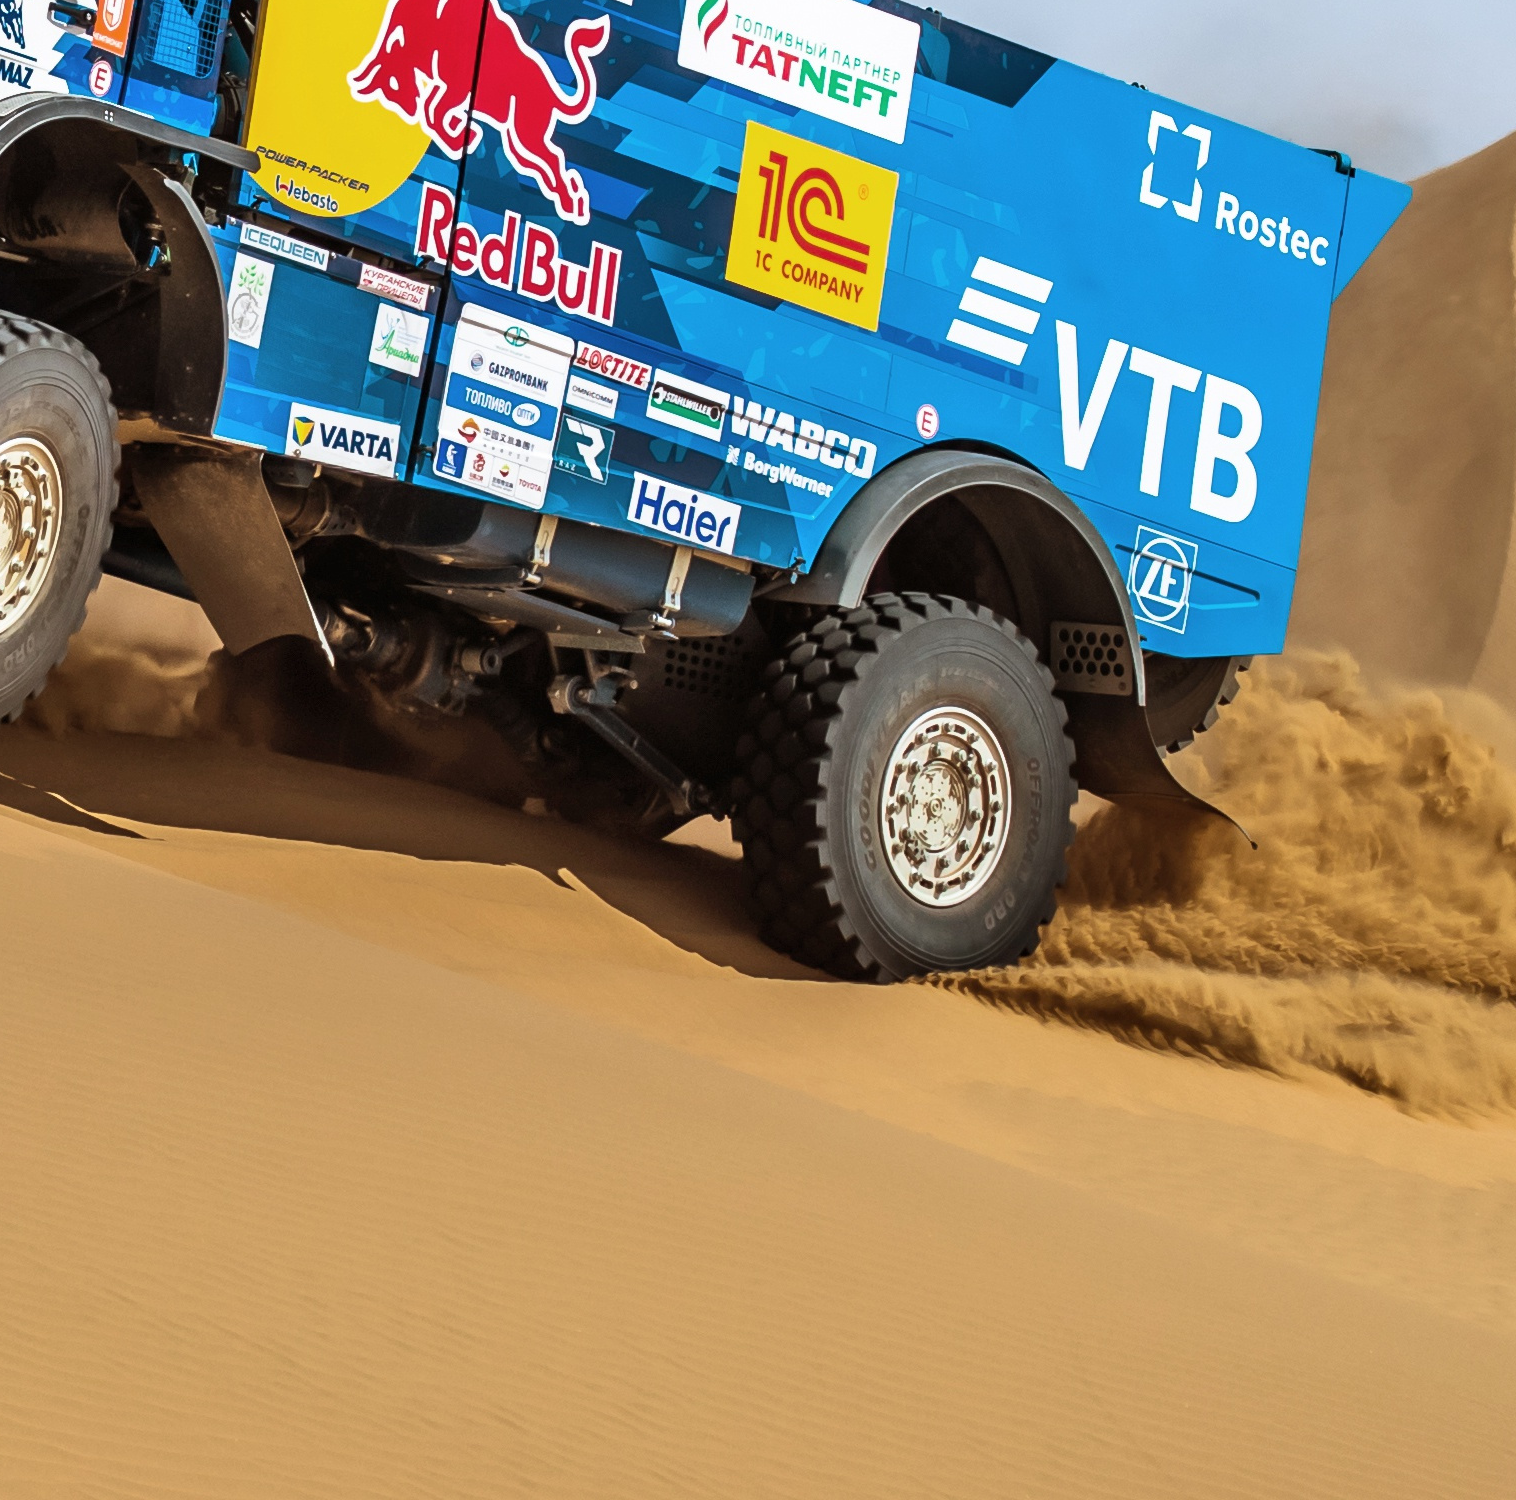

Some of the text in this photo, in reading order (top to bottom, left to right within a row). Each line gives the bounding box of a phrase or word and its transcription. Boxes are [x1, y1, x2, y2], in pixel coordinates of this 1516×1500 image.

[735, 13, 902, 85] ТОПЛИВНЫЙ ПАРТНЕР
[731, 32, 898, 118] TATNEFT
[255, 145, 370, 194] POWER-PACKER
[275, 173, 339, 213] Webasto
[244, 227, 326, 266] ICEQUEEN
[1215, 190, 1330, 268] Rostec
[415, 182, 622, 327] Red Bull
[363, 268, 427, 296] КУРГАНСКИЕ
[781, 259, 864, 304] COMPANY
[488, 361, 549, 392] GAZPROMBANK
[576, 346, 649, 388] LOCTITE
[465, 386, 513, 416] ТОПЛИВО
[1054, 319, 1264, 524] VTB
[319, 421, 393, 462] VARTA
[731, 395, 878, 479] WABCO
[743, 451, 834, 498] BorgWarner
[634, 479, 732, 548] Haier
